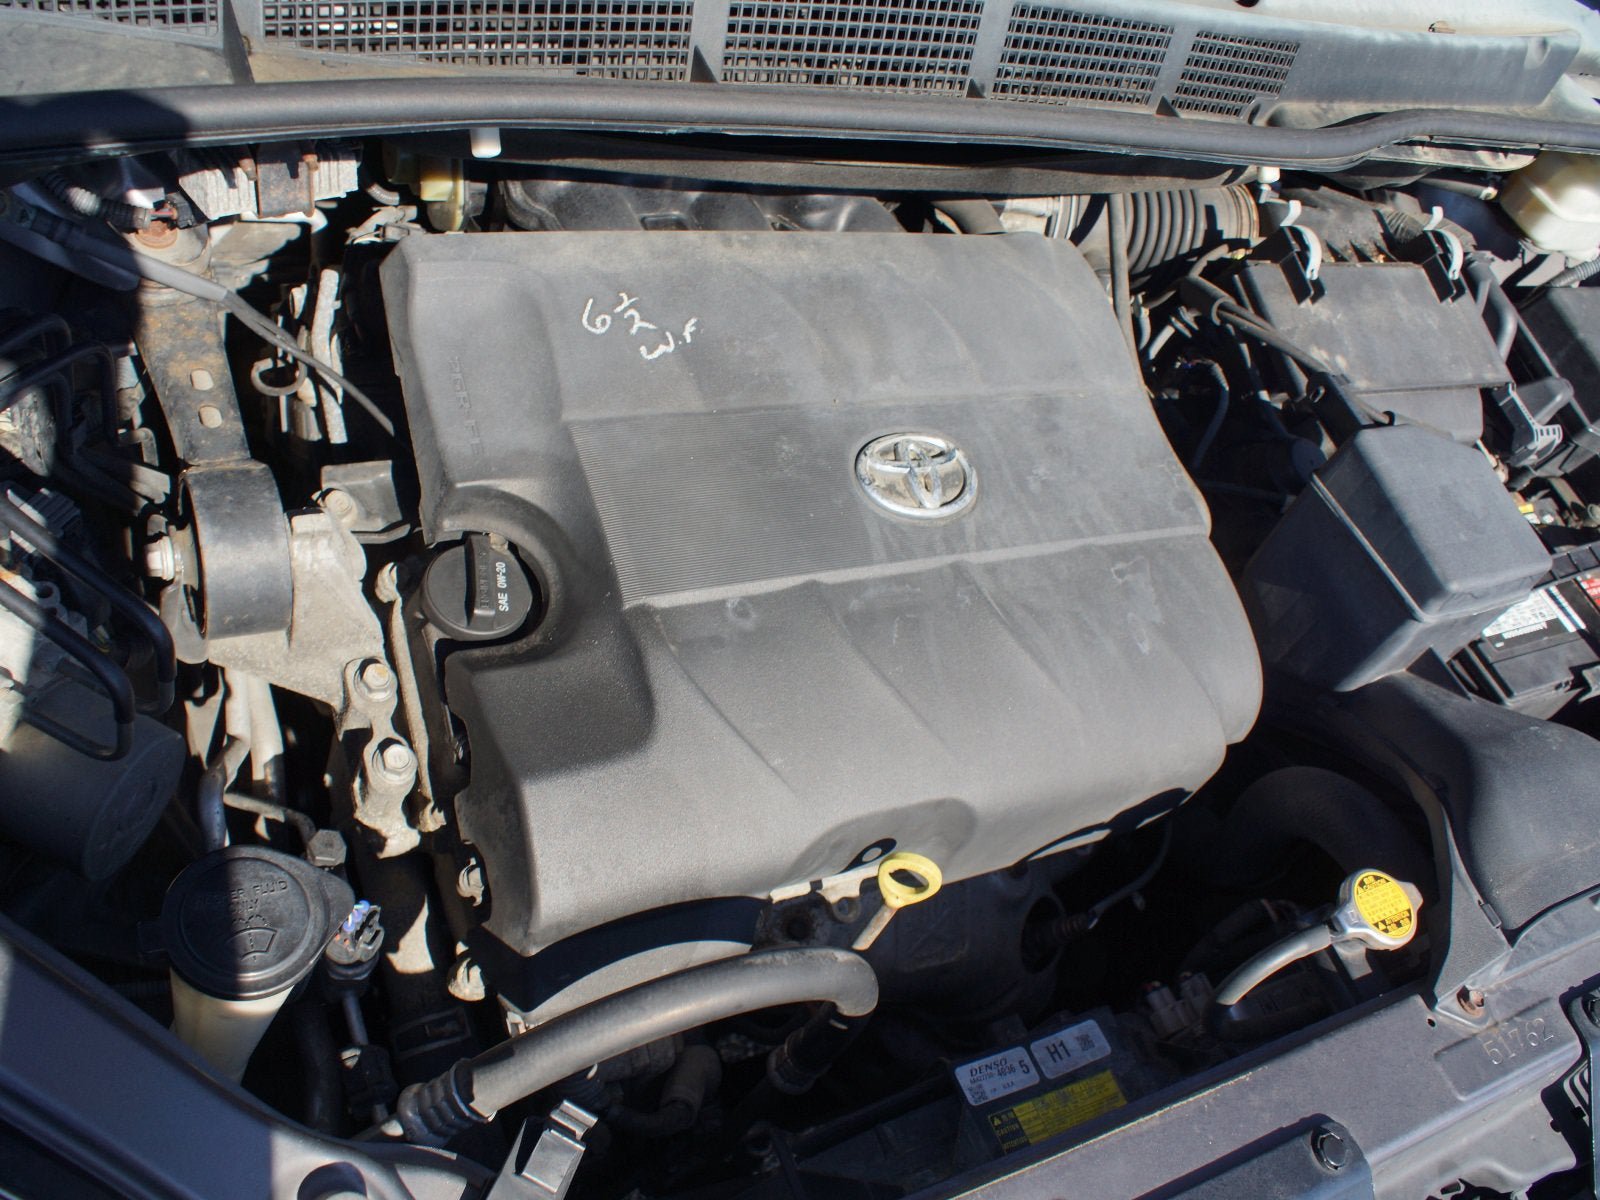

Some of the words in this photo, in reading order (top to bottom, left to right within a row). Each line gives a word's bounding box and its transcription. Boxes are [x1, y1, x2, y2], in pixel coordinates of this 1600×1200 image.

[495, 561, 507, 589] 0W-20
[497, 592, 509, 612] SAE
[253, 880, 288, 897] FLUID
[1046, 1040, 1071, 1063] H1
[1482, 1018, 1554, 1065] 51762
[970, 1057, 1008, 1077] DENSO
[1018, 1059, 1030, 1074] 5
